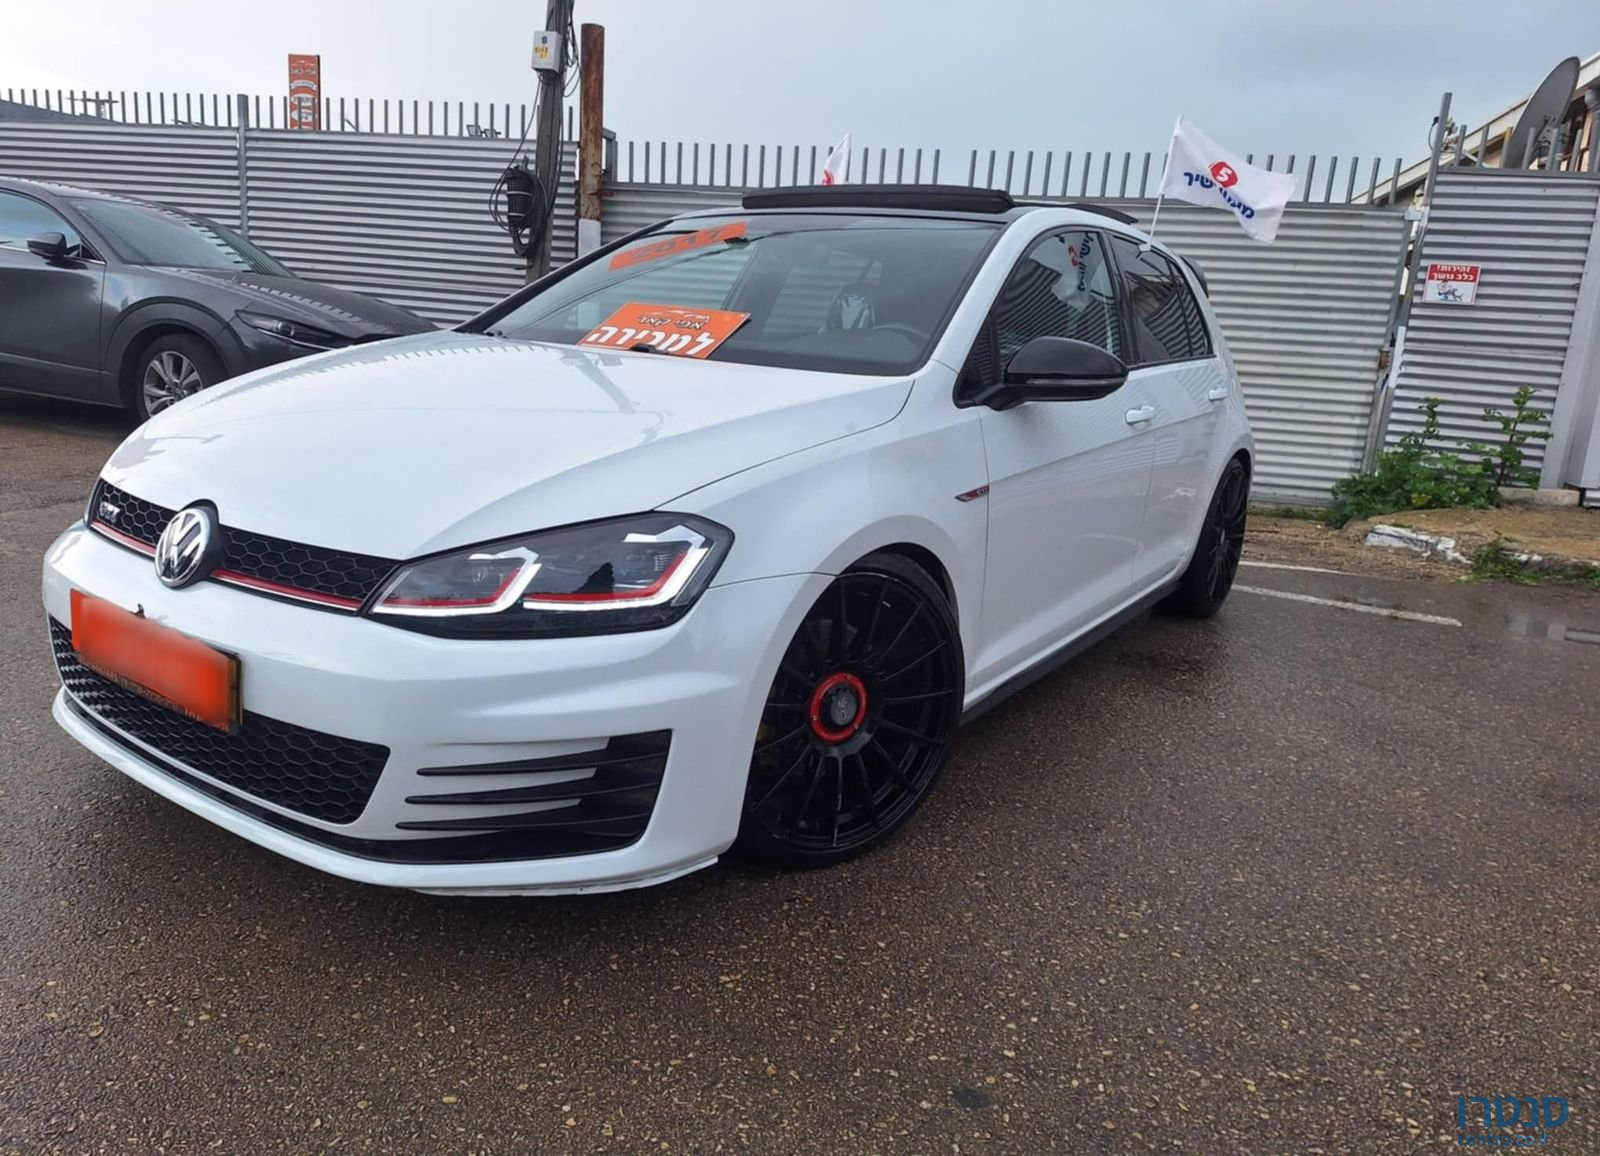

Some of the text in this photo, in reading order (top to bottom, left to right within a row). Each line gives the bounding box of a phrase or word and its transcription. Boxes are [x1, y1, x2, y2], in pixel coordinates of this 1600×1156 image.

[632, 226, 724, 259] 2017
[1431, 272, 1474, 281] כלב נושך
[586, 326, 716, 355] למכירה
